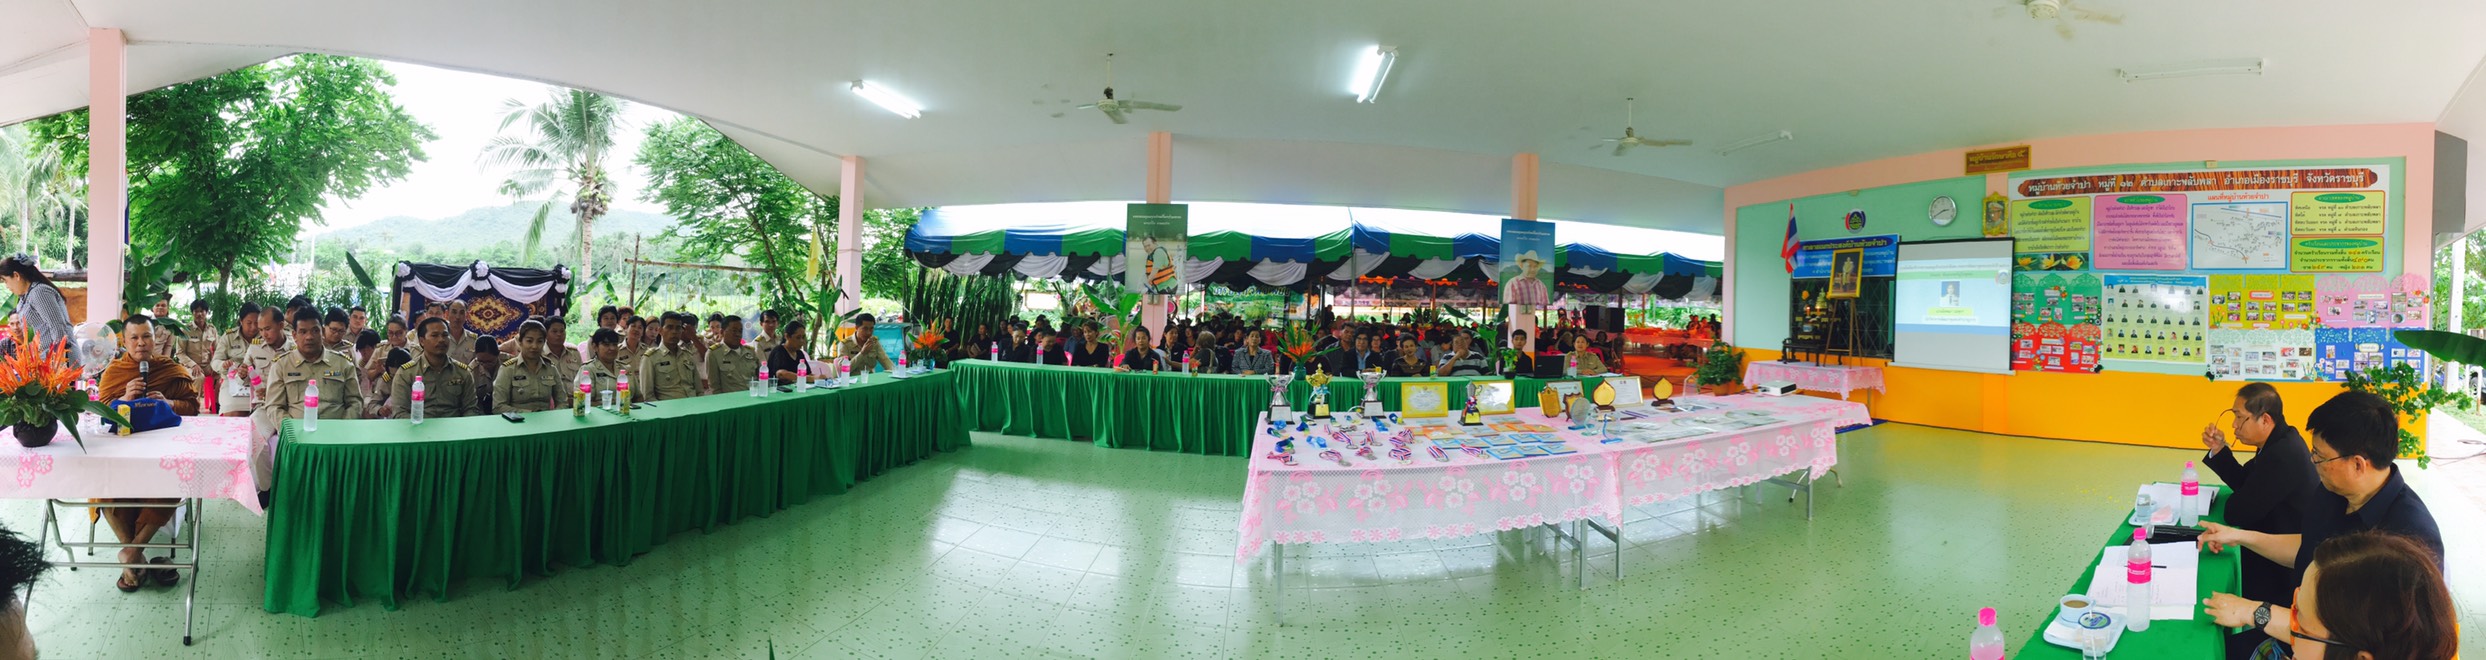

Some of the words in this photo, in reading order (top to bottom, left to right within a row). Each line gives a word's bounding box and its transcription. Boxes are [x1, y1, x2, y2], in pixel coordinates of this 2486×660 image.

[2028, 178, 2091, 195] หมู่บ้านห้วยจำปา
[2098, 175, 2116, 193] หมู่ที่
[2140, 174, 2217, 188] ตำบลเกาะพลับพลา
[2224, 173, 2299, 188] อำเภอเมืองราชบุรี
[2306, 171, 2365, 187] จังหวัดราชบุรี
